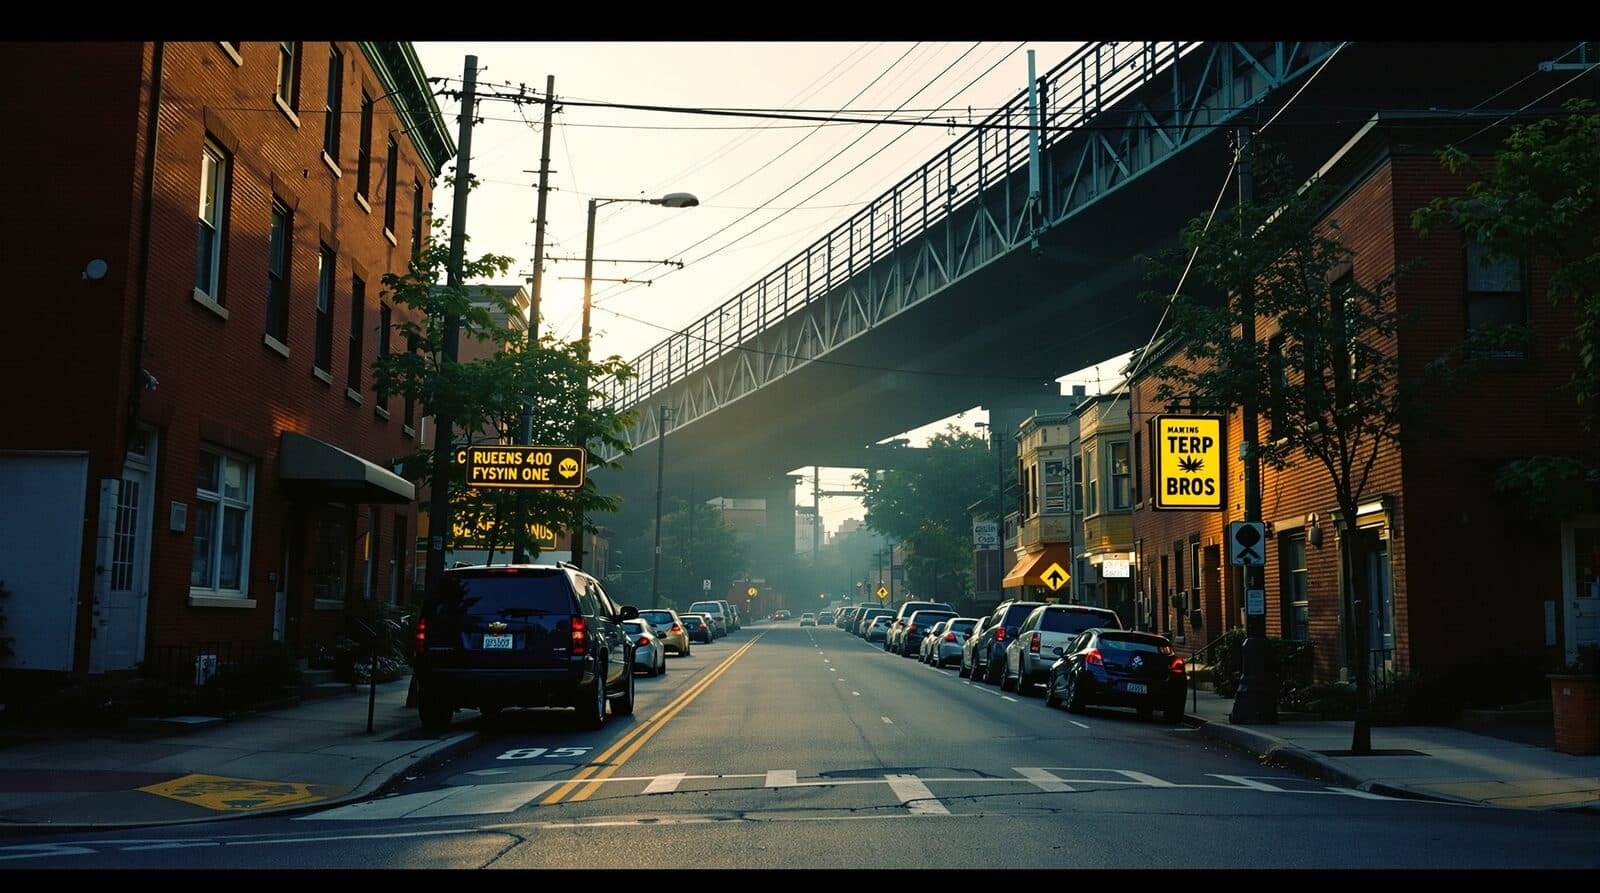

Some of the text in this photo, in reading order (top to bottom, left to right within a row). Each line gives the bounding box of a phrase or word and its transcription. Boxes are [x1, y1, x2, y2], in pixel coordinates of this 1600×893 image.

[1167, 436, 1214, 454] TERP
[473, 451, 553, 466] RUEENS 400
[472, 466, 551, 481] FYSYIN ONE
[1166, 477, 1216, 496] BROS
